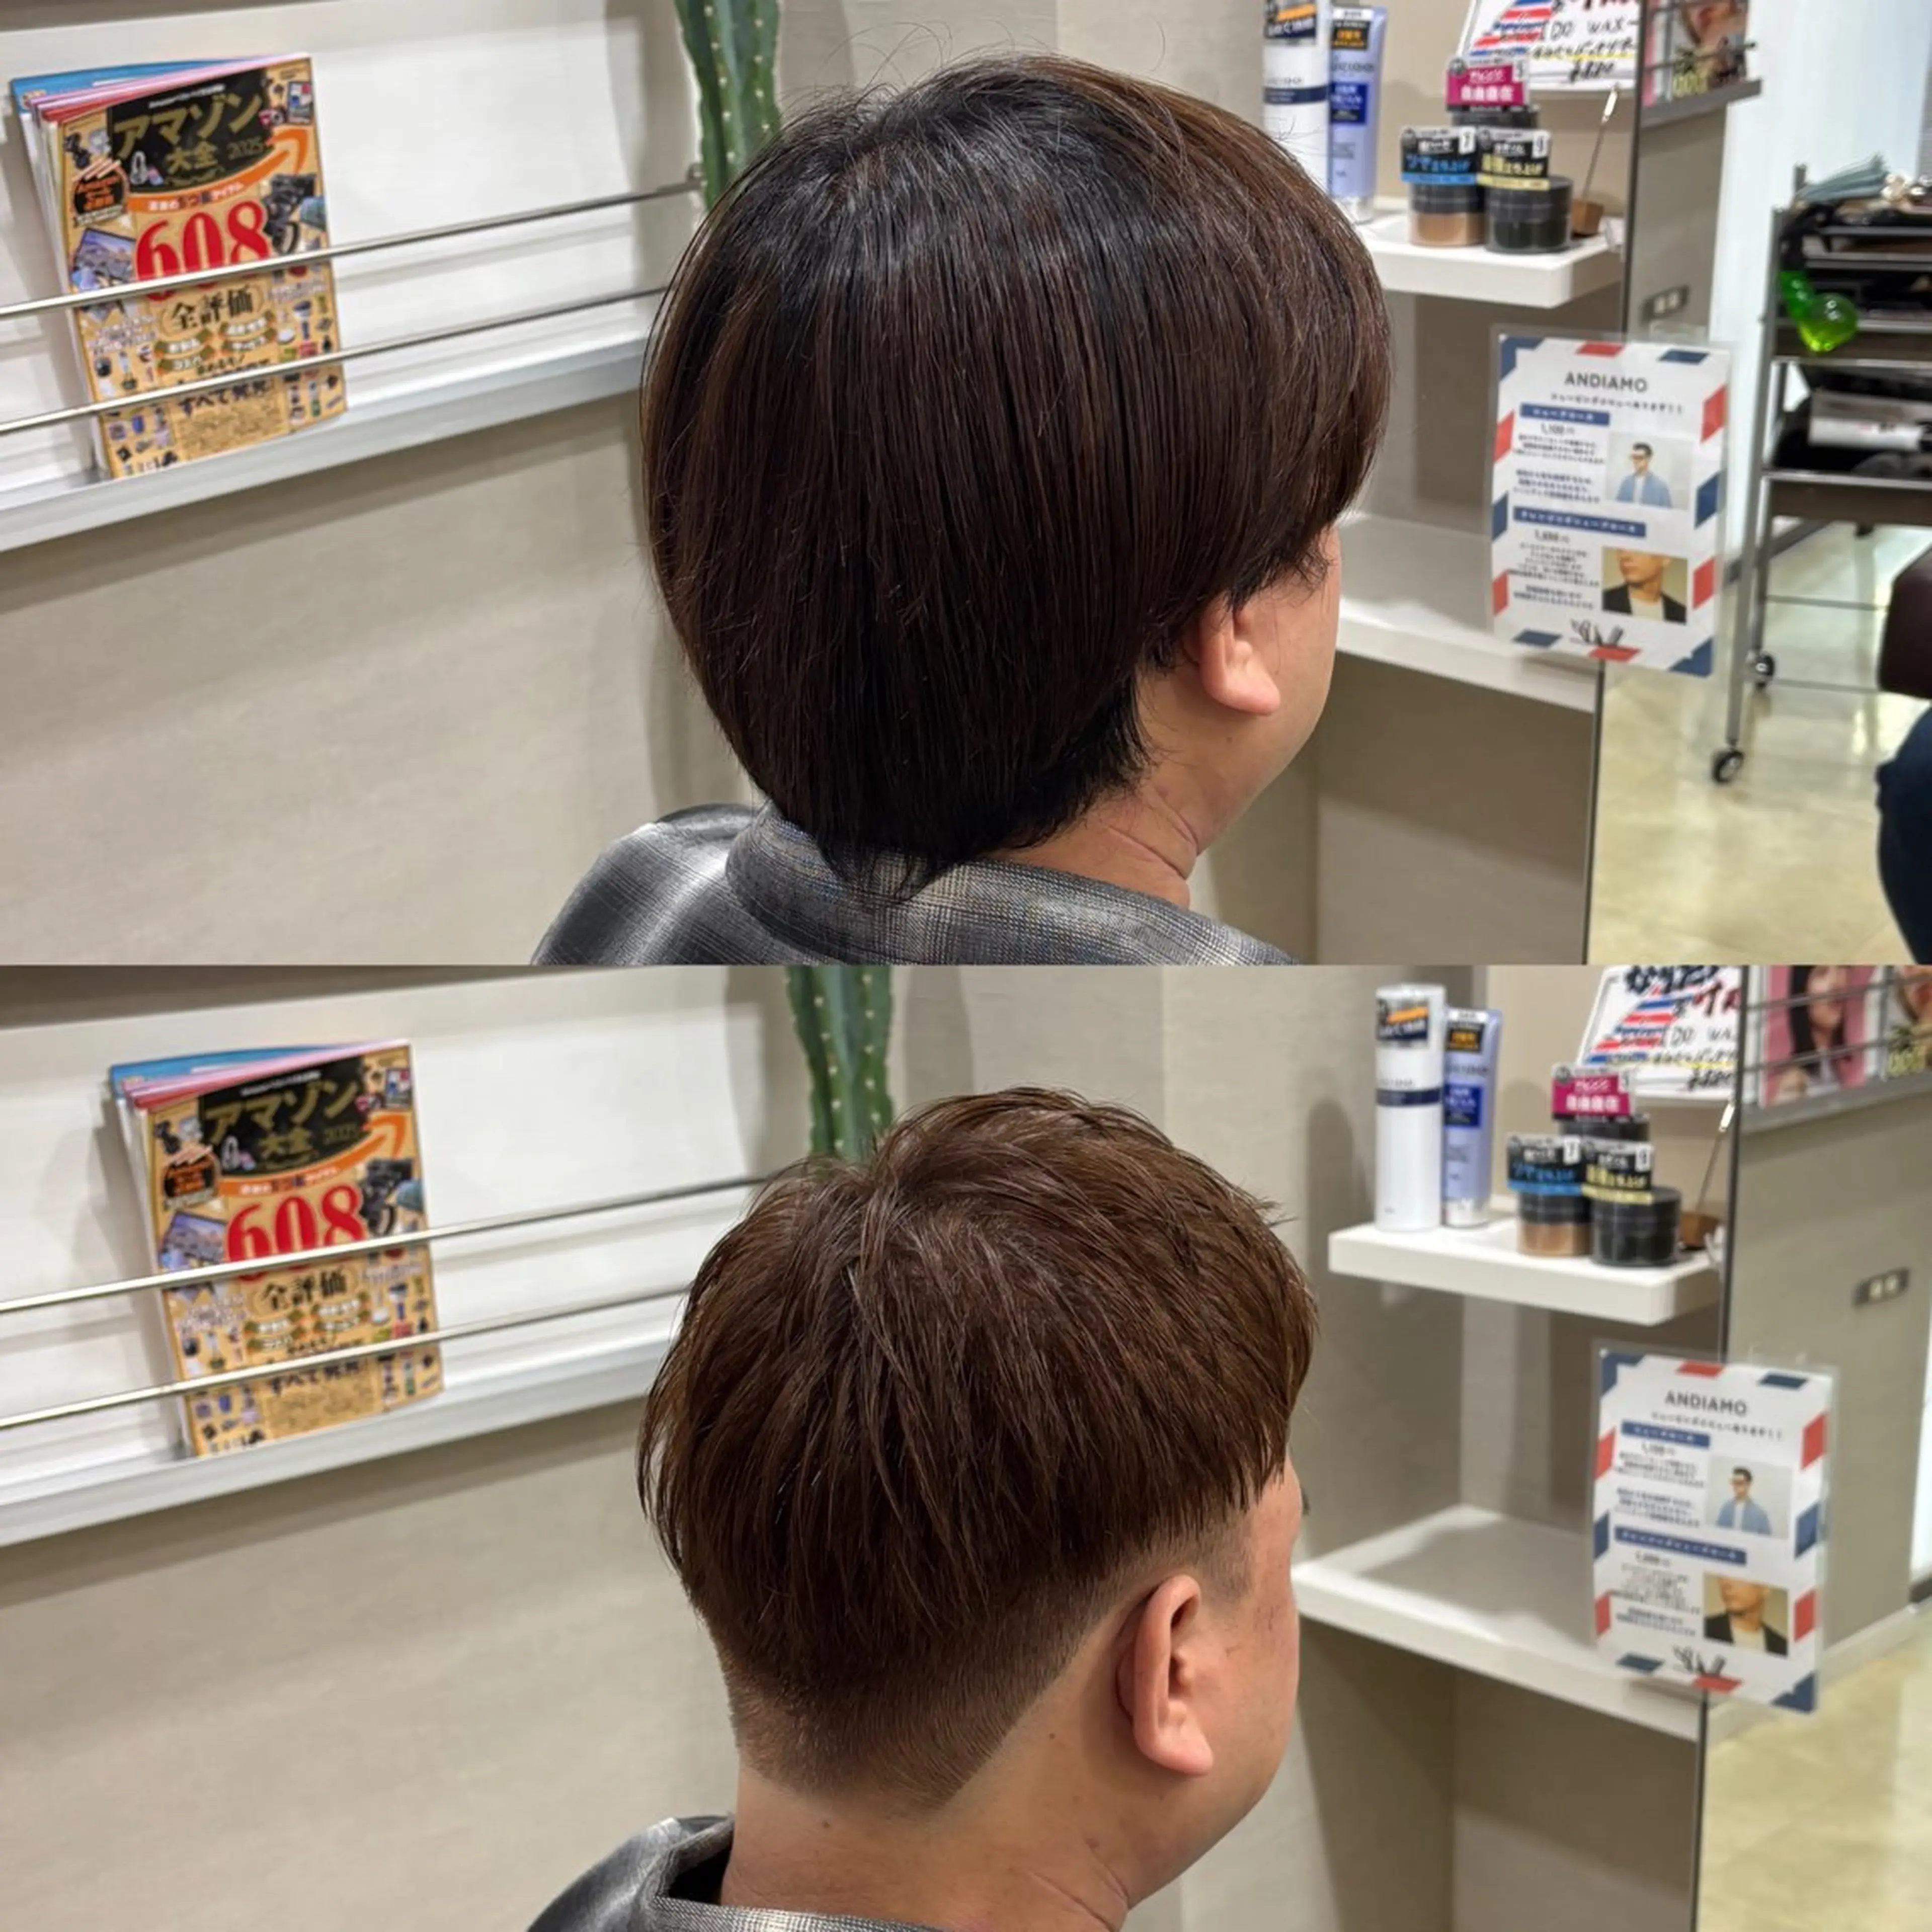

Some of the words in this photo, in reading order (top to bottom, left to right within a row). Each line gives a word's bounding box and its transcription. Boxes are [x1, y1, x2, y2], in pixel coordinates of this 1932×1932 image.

[114, 92, 262, 159] アマゾン
[167, 141, 218, 174] 大全
[136, 200, 271, 301] 608
[172, 288, 253, 330] 全評価
[1564, 371, 1648, 393] ANDIAMO
[204, 1079, 358, 1146] アマゾン
[258, 1127, 314, 1156] 大全
[227, 1184, 365, 1284] 608
[263, 1270, 347, 1311] 全評価
[1665, 1390, 1747, 1416] ANDIAMO
